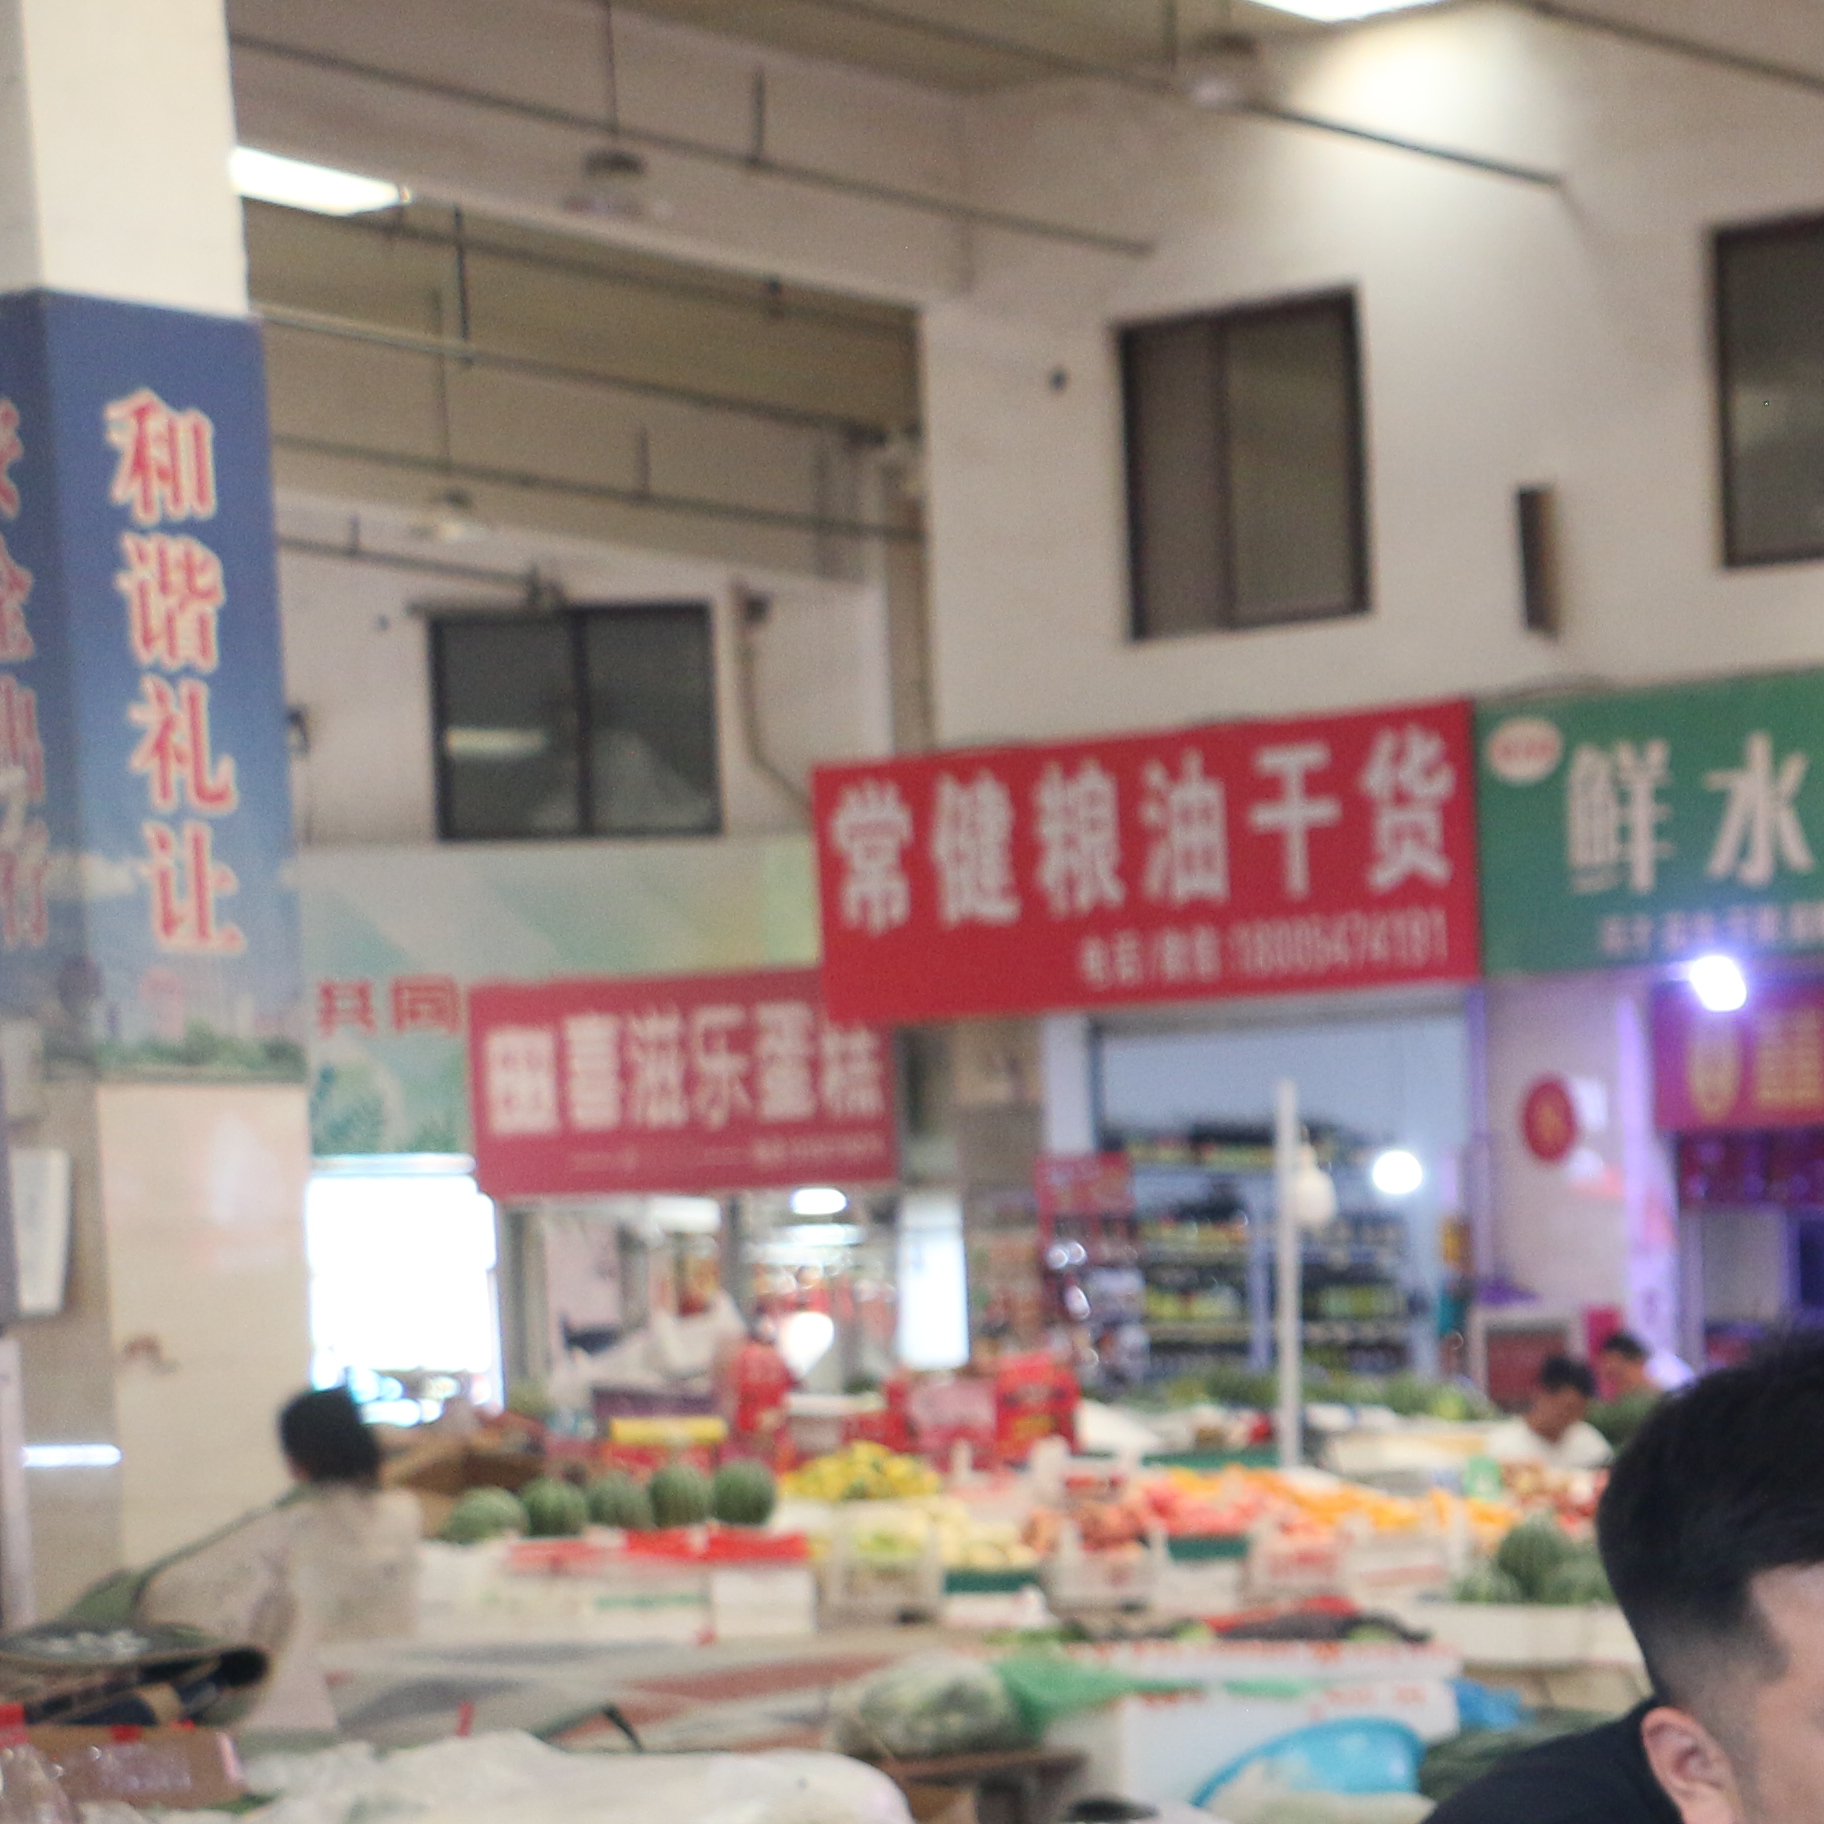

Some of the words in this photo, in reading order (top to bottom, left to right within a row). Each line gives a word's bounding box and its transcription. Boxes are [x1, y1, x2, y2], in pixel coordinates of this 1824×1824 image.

[105, 388, 247, 955] 和谐礼让
[830, 725, 1456, 936] 常健粮油干货
